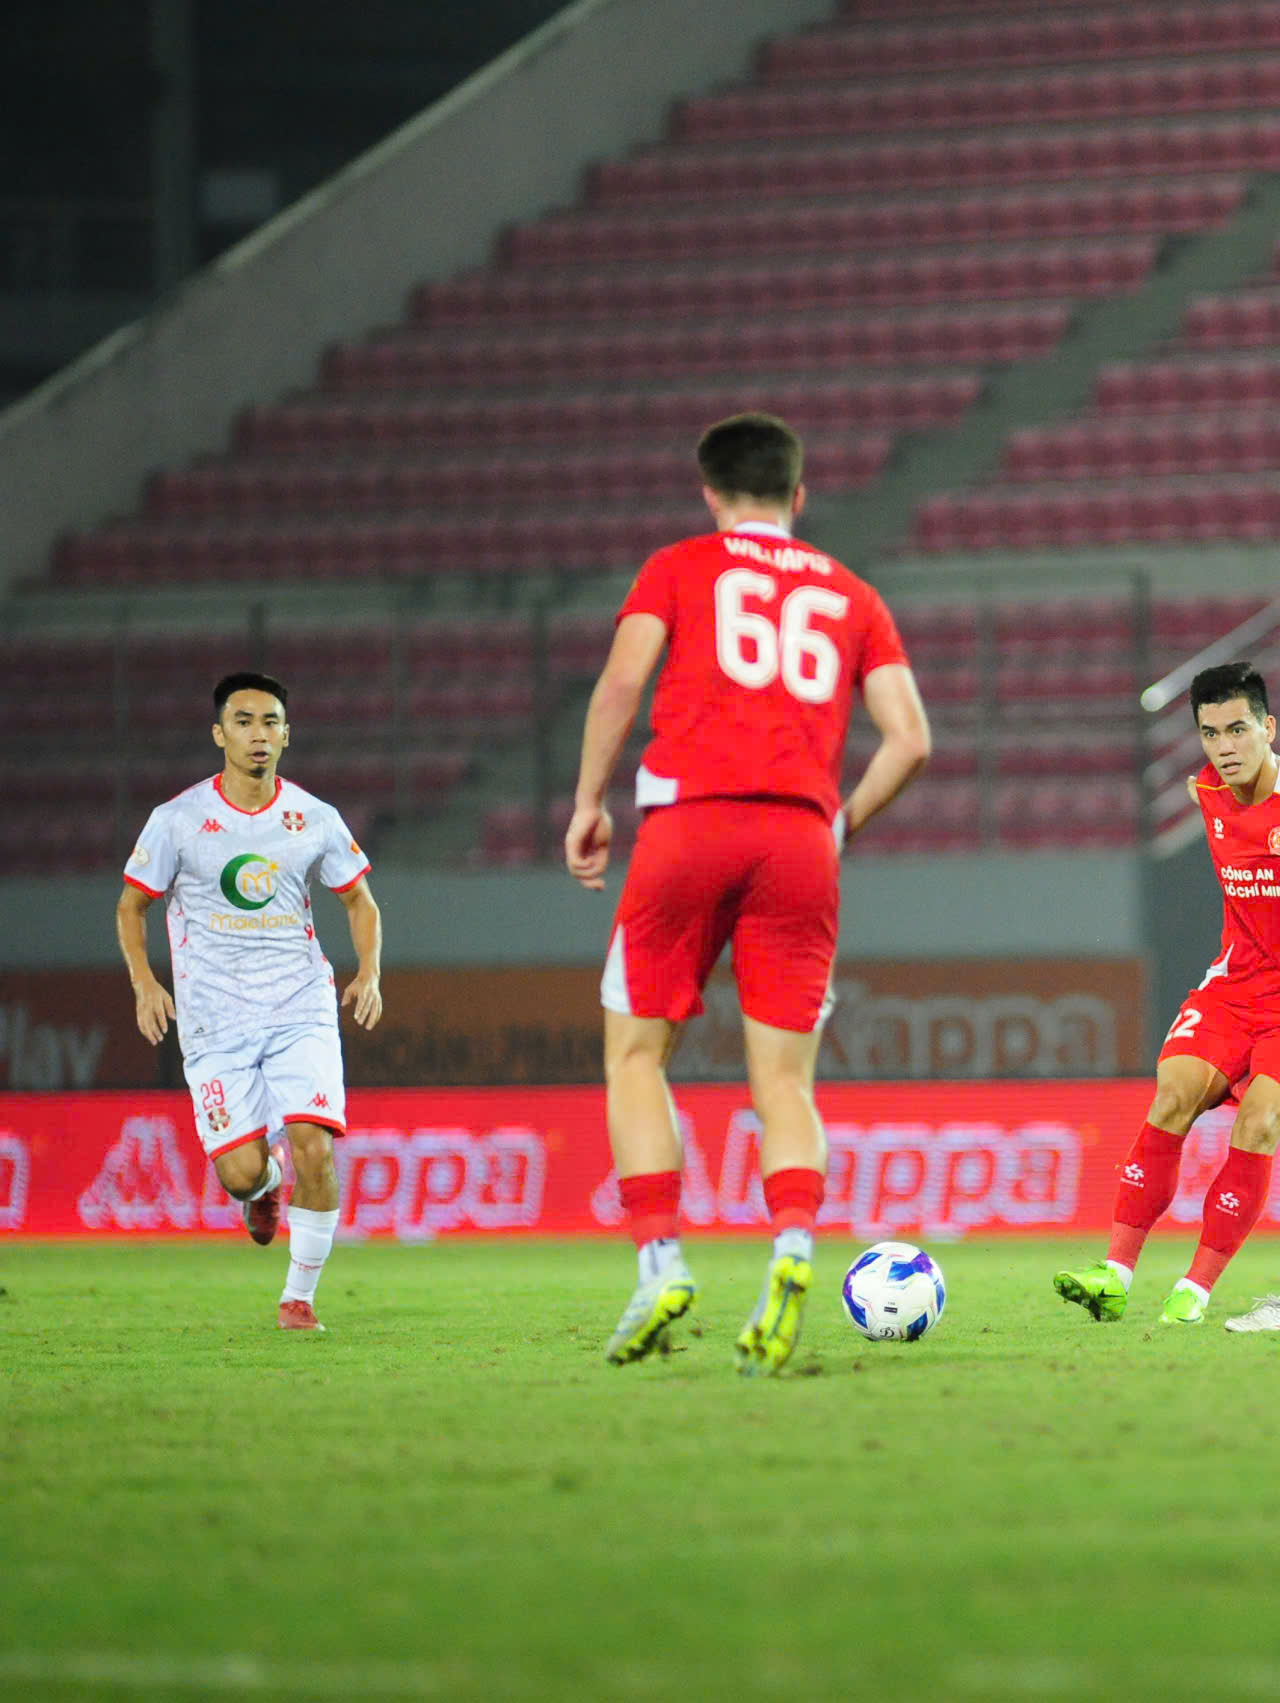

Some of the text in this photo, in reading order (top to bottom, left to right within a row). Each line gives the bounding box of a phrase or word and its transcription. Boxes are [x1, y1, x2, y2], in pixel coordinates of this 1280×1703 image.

[714, 567, 848, 705] 66
[1220, 865, 1274, 882] CÔNG AN
[200, 1079, 225, 1111] 29
[203, 1127, 549, 1243] ppa
